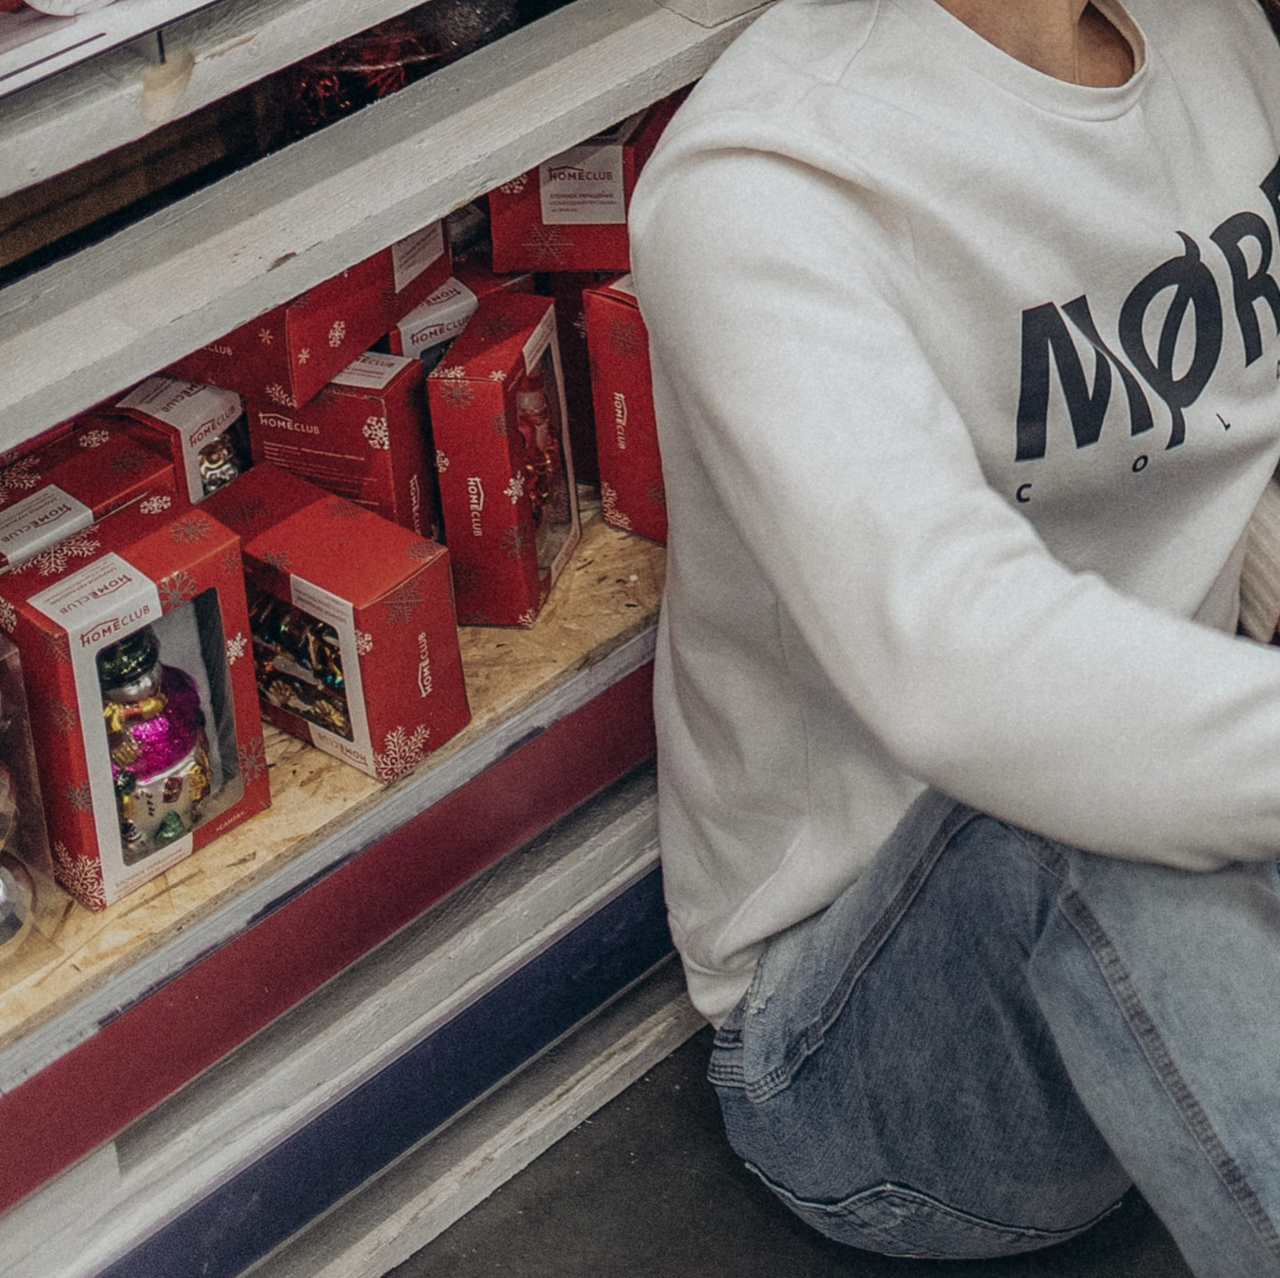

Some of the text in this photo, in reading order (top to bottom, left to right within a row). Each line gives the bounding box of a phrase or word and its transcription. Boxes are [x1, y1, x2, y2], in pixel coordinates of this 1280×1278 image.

[547, 165, 614, 182] HOMECLUB
[188, 404, 236, 448] HOMECLUB
[258, 411, 320, 436] HOMECLUB
[613, 392, 628, 450] HOMECLUB
[466, 476, 484, 537] HOMECLUB
[59, 574, 132, 615] HOMECLUB
[80, 604, 150, 649] HOMECLUB
[417, 631, 433, 699] HOMECLUB
